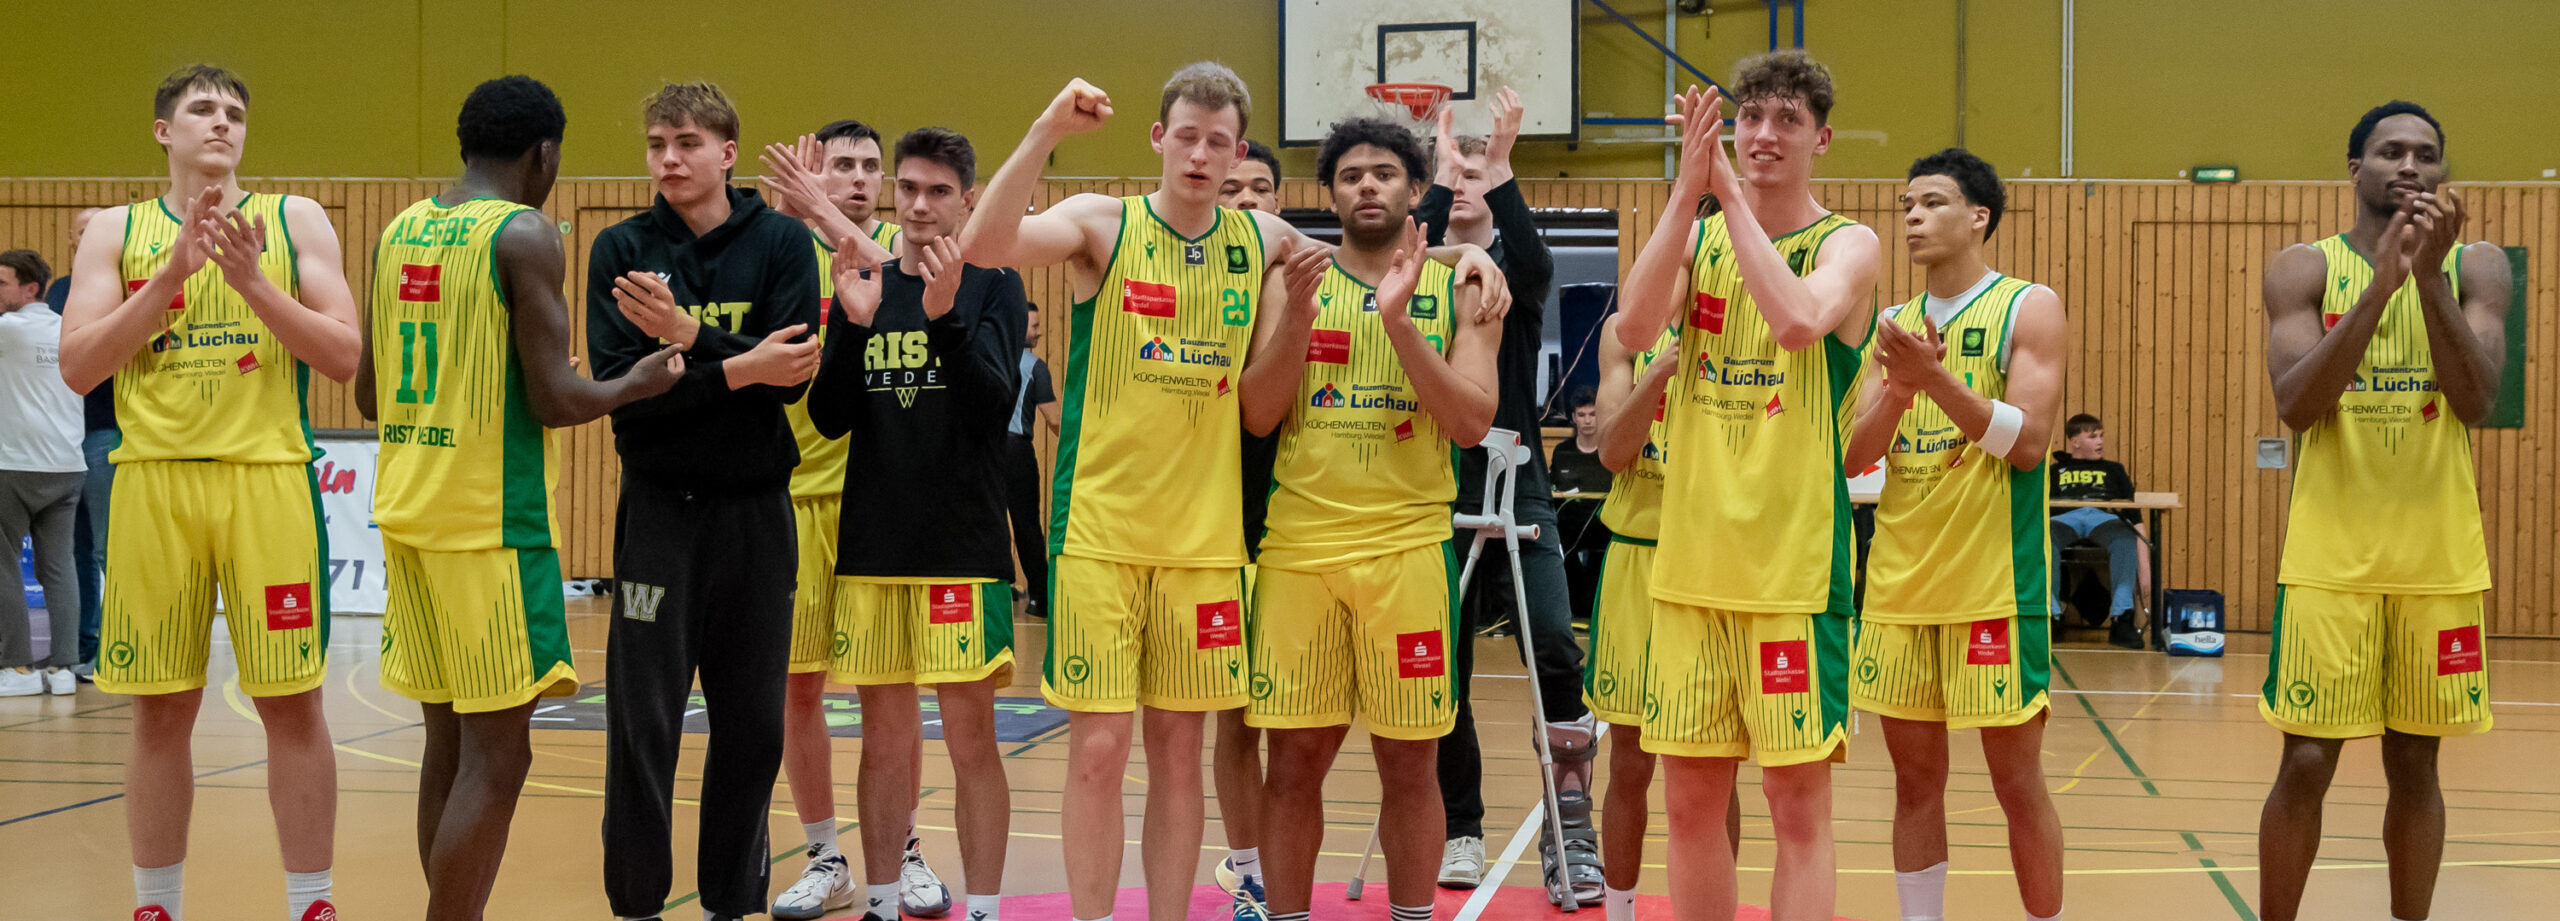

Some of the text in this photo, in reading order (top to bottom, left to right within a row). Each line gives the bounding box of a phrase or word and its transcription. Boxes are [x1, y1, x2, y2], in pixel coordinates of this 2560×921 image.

[659, 302, 753, 345] IST
[187, 331, 259, 348] Lüchau
[864, 330, 942, 371] RIS
[1180, 347, 1231, 368] Lüchau
[396, 321, 438, 405] 11
[2372, 366, 2428, 374] Bauzentrum
[1132, 371, 1212, 388] KÜCHENWELTEN
[1721, 367, 1785, 387] Lüchau
[1351, 384, 1403, 393] Bauzentrum
[1350, 393, 1418, 412] Lüchau
[1692, 394, 1755, 411] KHENWELTEN
[383, 423, 417, 444] RIST
[1304, 419, 1387, 431] KÜCHENWELTEN
[2059, 470, 2107, 486] RIST
[621, 581, 665, 622] W
